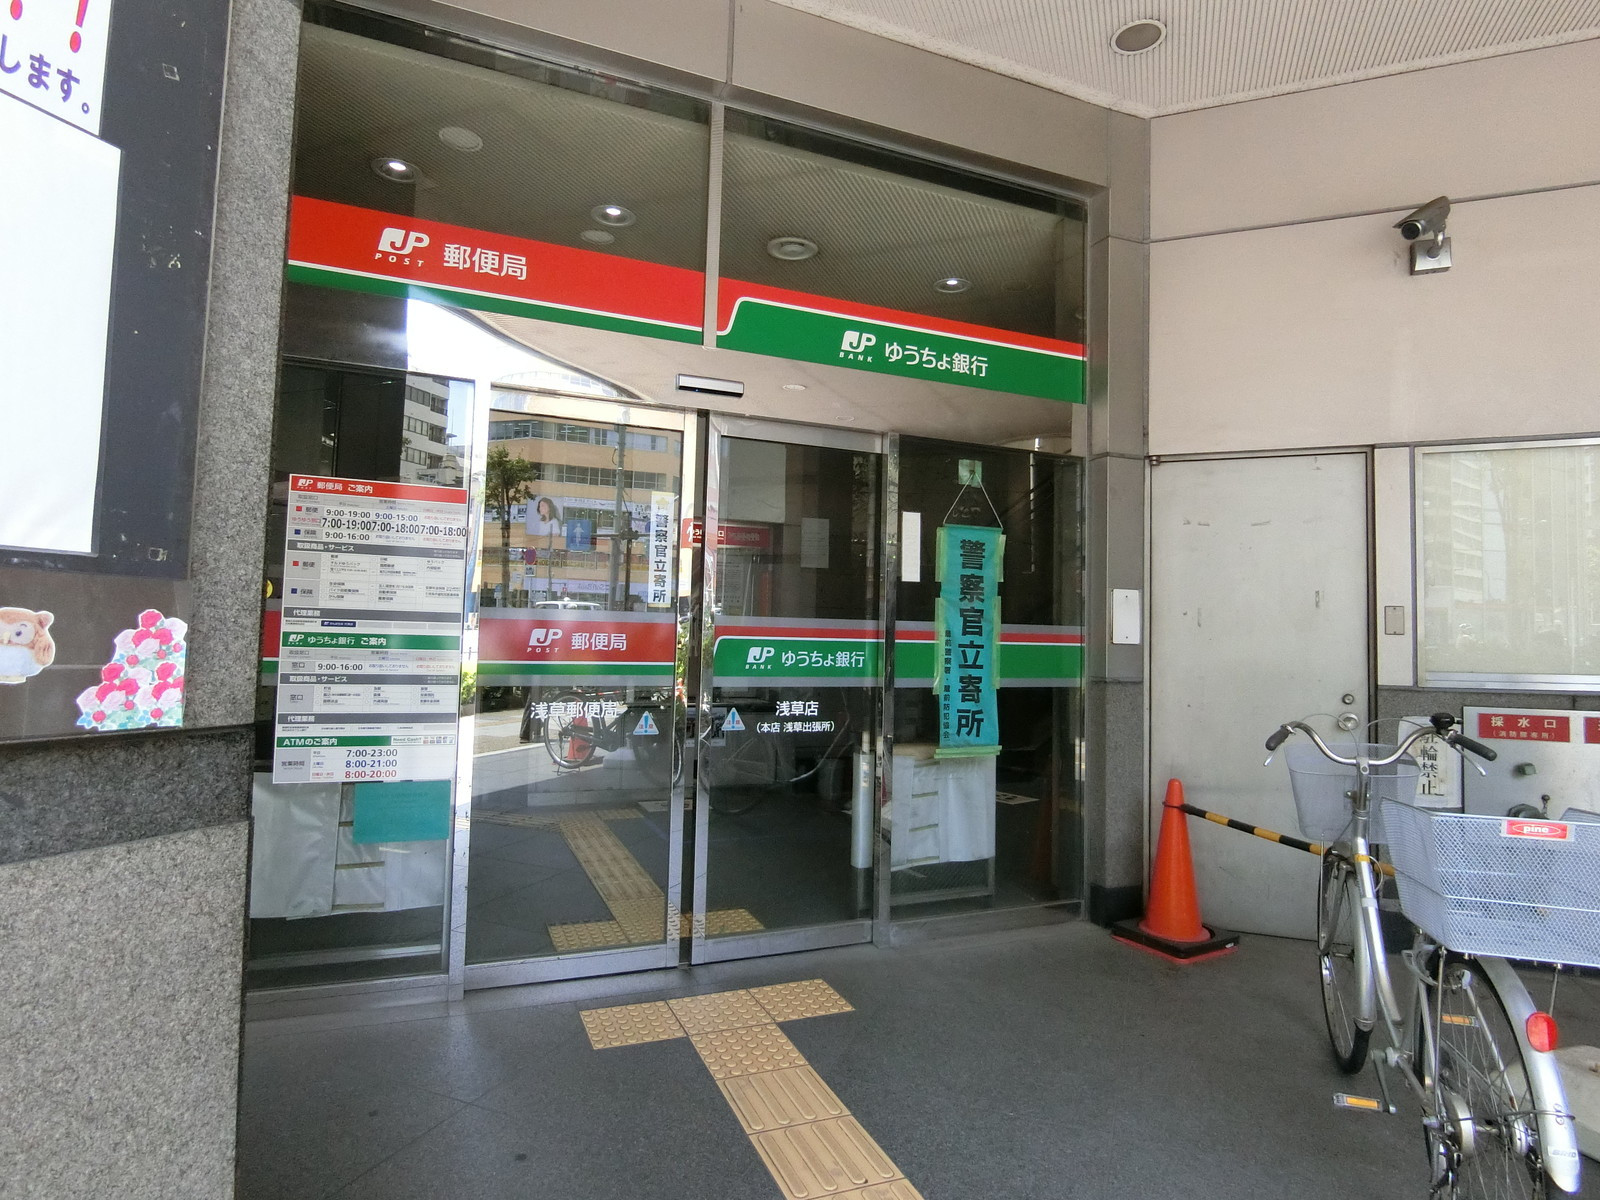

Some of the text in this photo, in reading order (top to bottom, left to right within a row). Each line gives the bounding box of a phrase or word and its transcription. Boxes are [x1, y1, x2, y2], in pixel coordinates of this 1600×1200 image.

[375, 252, 424, 267] POST
[443, 243, 528, 281] 郵便局
[839, 352, 873, 363] BANK
[884, 342, 988, 377] ゆうちょ銀行
[317, 482, 343, 491] 郵便局
[348, 484, 374, 494] ご案内
[326, 509, 371, 519] 9:00-19:00
[375, 512, 418, 522] 9:00-15:00
[322, 518, 372, 531] 7:00-19:00
[371, 521, 420, 534] 7:00-18:00
[420, 524, 467, 537] 7:00-18:00
[325, 532, 370, 541] 9:00-16:00
[652, 513, 669, 603] 警察官立寄所
[307, 636, 356, 645] ゆうちょ銀行
[360, 637, 387, 646] ご案内
[571, 633, 627, 651] 郵便局
[956, 539, 986, 738] 警察官立寄所
[781, 650, 865, 668] ゆうちょ銀行
[317, 663, 363, 671] 9:00-16:00
[530, 701, 619, 719] 浅草郵便局
[775, 701, 819, 717] 浅草店
[1491, 716, 1557, 729] 採水口
[283, 737, 338, 746] ATMのご案内
[346, 749, 398, 758] 7:00-23:00
[345, 759, 397, 768] 8:00-21:00
[345, 770, 397, 778] 8:00-20:00
